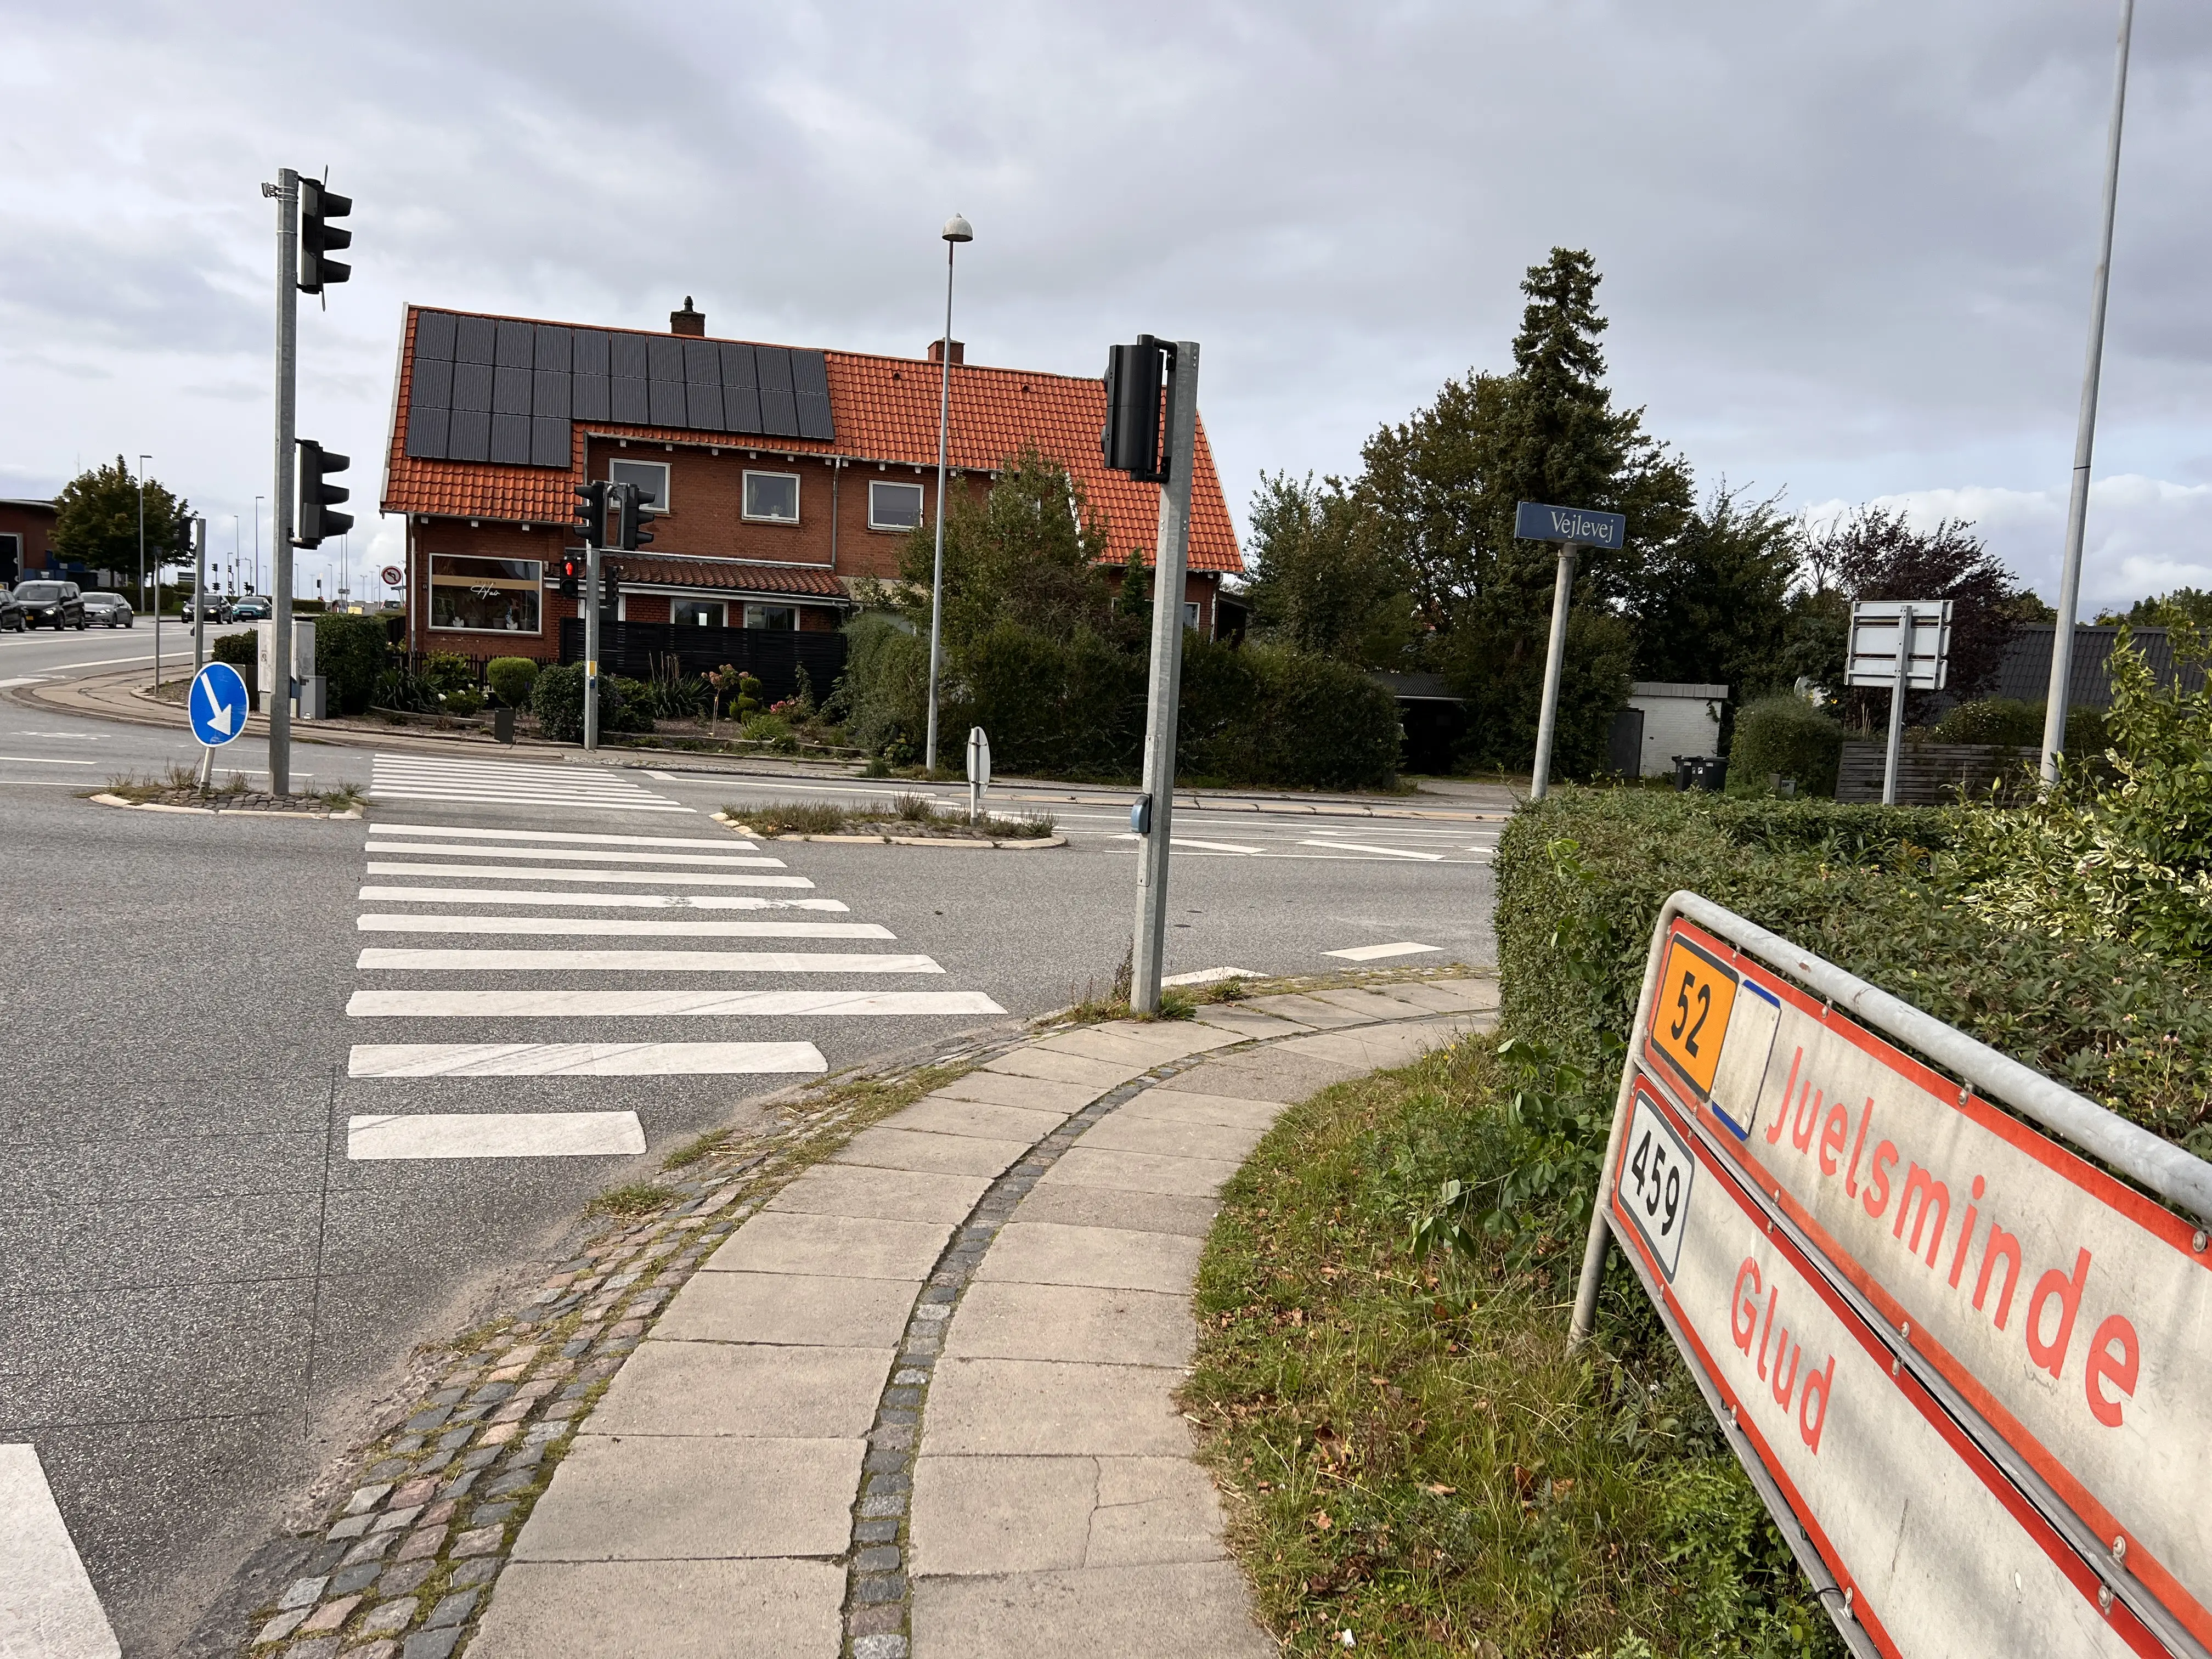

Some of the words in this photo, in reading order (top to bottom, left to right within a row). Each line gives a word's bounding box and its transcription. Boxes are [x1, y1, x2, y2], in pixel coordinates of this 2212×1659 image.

[1550, 511, 1614, 543] Vejlevej
[470, 582, 501, 600] Hair
[1671, 971, 1713, 1058] 52
[1630, 1130, 1680, 1237] 459
[1767, 1046, 2140, 1428] Juelsminde
[1730, 1256, 1836, 1455] Glud
